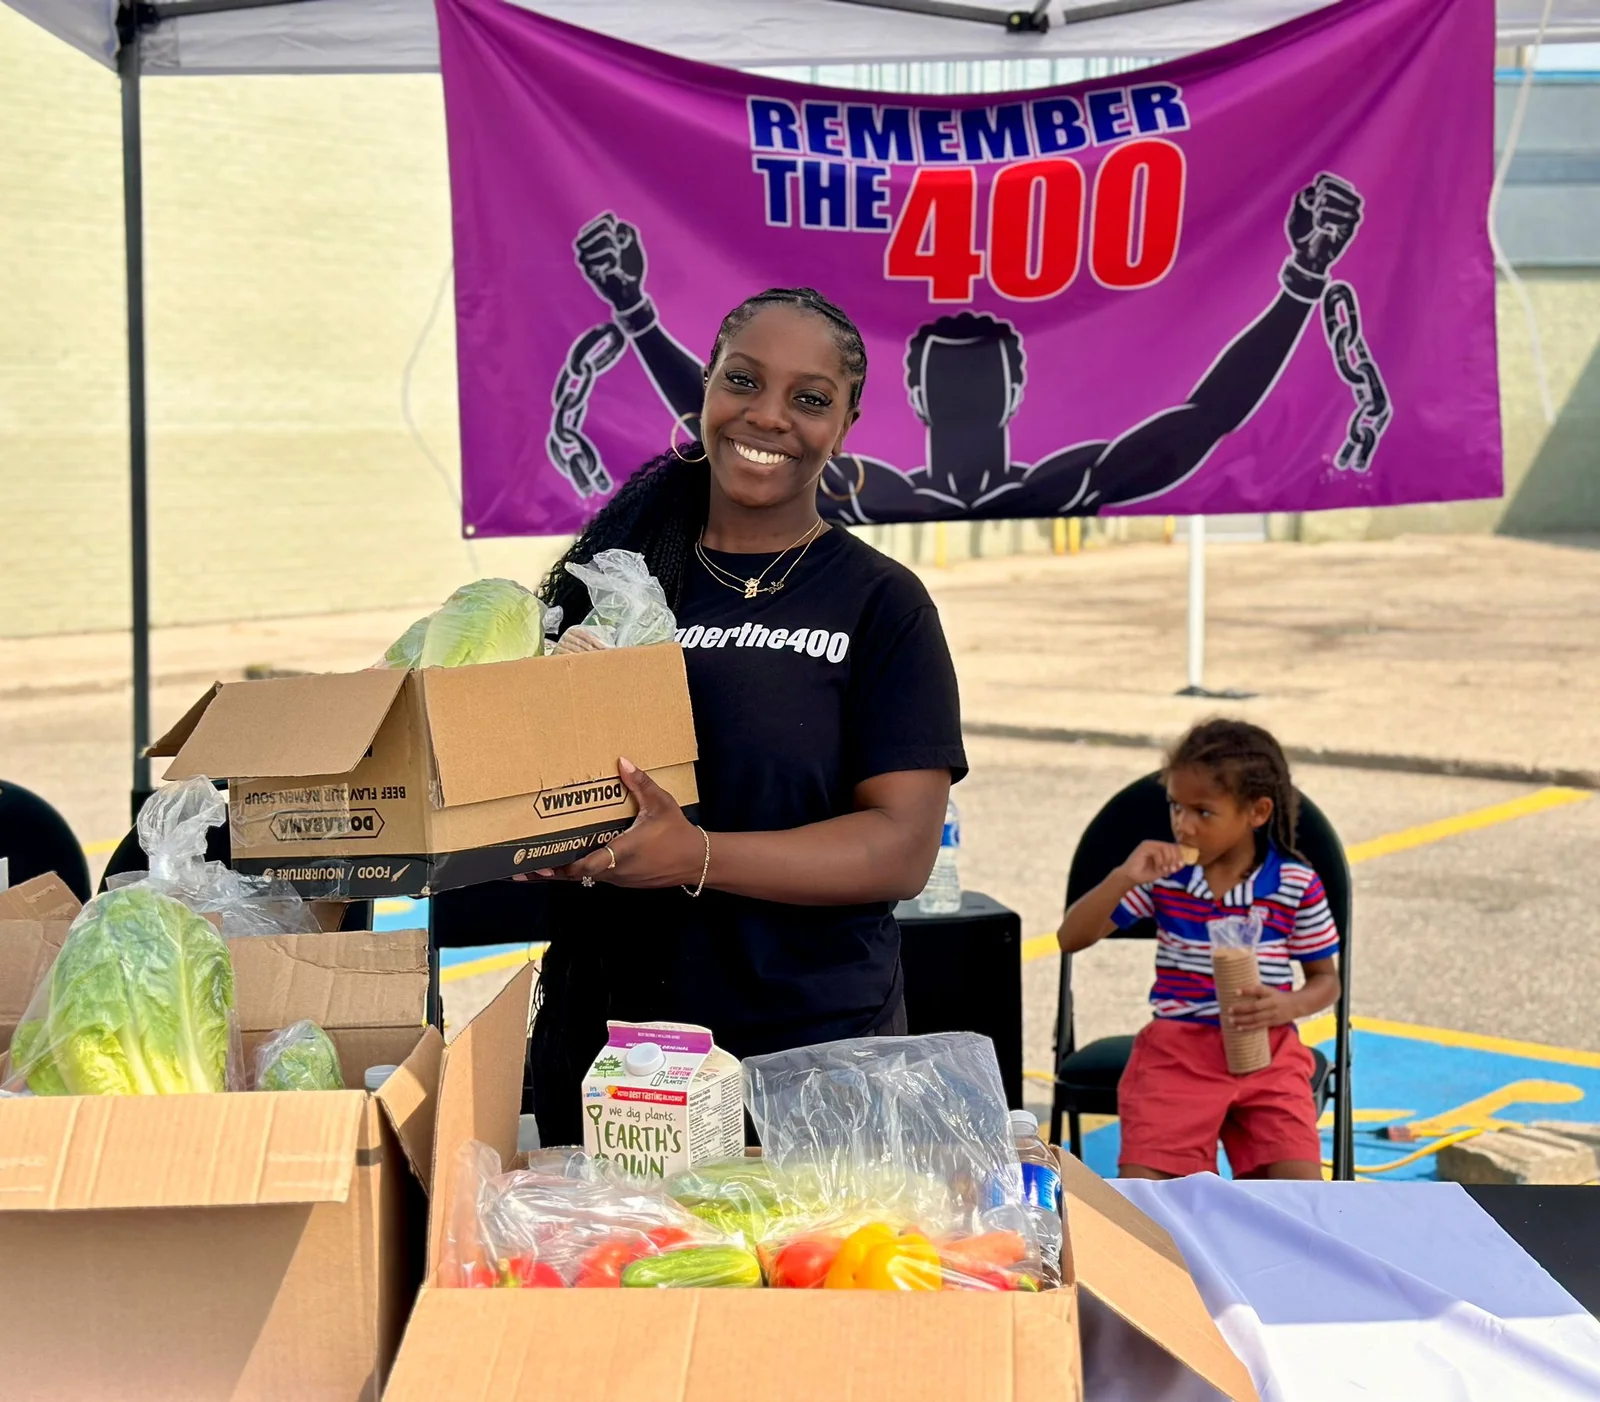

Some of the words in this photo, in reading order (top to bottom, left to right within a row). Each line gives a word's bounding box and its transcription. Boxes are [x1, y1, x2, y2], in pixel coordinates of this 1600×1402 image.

[747, 82, 1190, 166] REMEMBER
[752, 154, 893, 234] THE
[884, 137, 1188, 303] 400
[244, 791, 278, 805] SOUP
[277, 788, 320, 804] RAMEN
[380, 786, 406, 800] BEEF
[541, 783, 622, 811] DOLLARAMA
[597, 829, 625, 844] OOD
[526, 836, 588, 859] NOURRITURE
[275, 867, 345, 882] NOURRITURE
[357, 866, 391, 880] FOOD
[609, 1107, 622, 1116] we
[626, 1106, 641, 1123] dig
[645, 1107, 676, 1122] plants.
